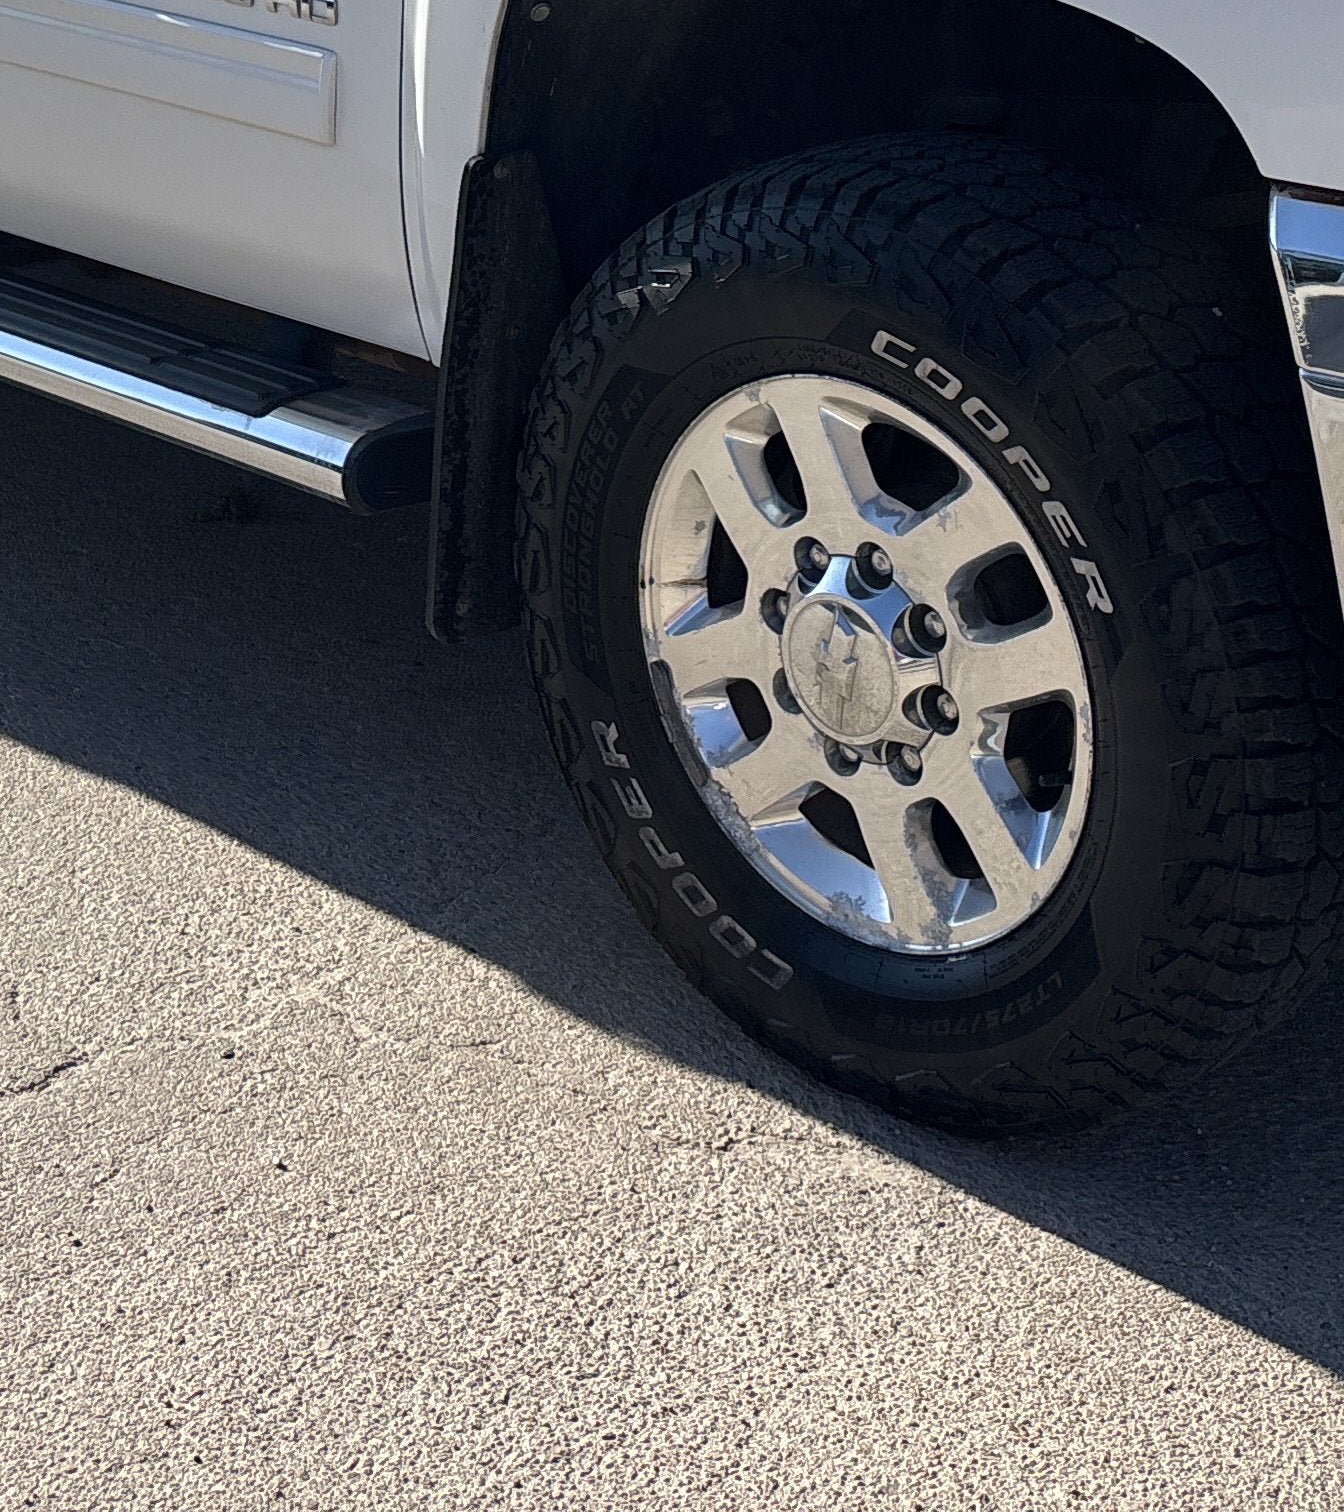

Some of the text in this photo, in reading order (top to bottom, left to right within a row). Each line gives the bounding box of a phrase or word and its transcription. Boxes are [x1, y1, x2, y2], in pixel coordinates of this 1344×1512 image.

[562, 399, 615, 614] DISCOVERER
[574, 425, 622, 662] STRONGHOLD
[869, 328, 1115, 615] COOPER
[590, 719, 794, 991] COOPER
